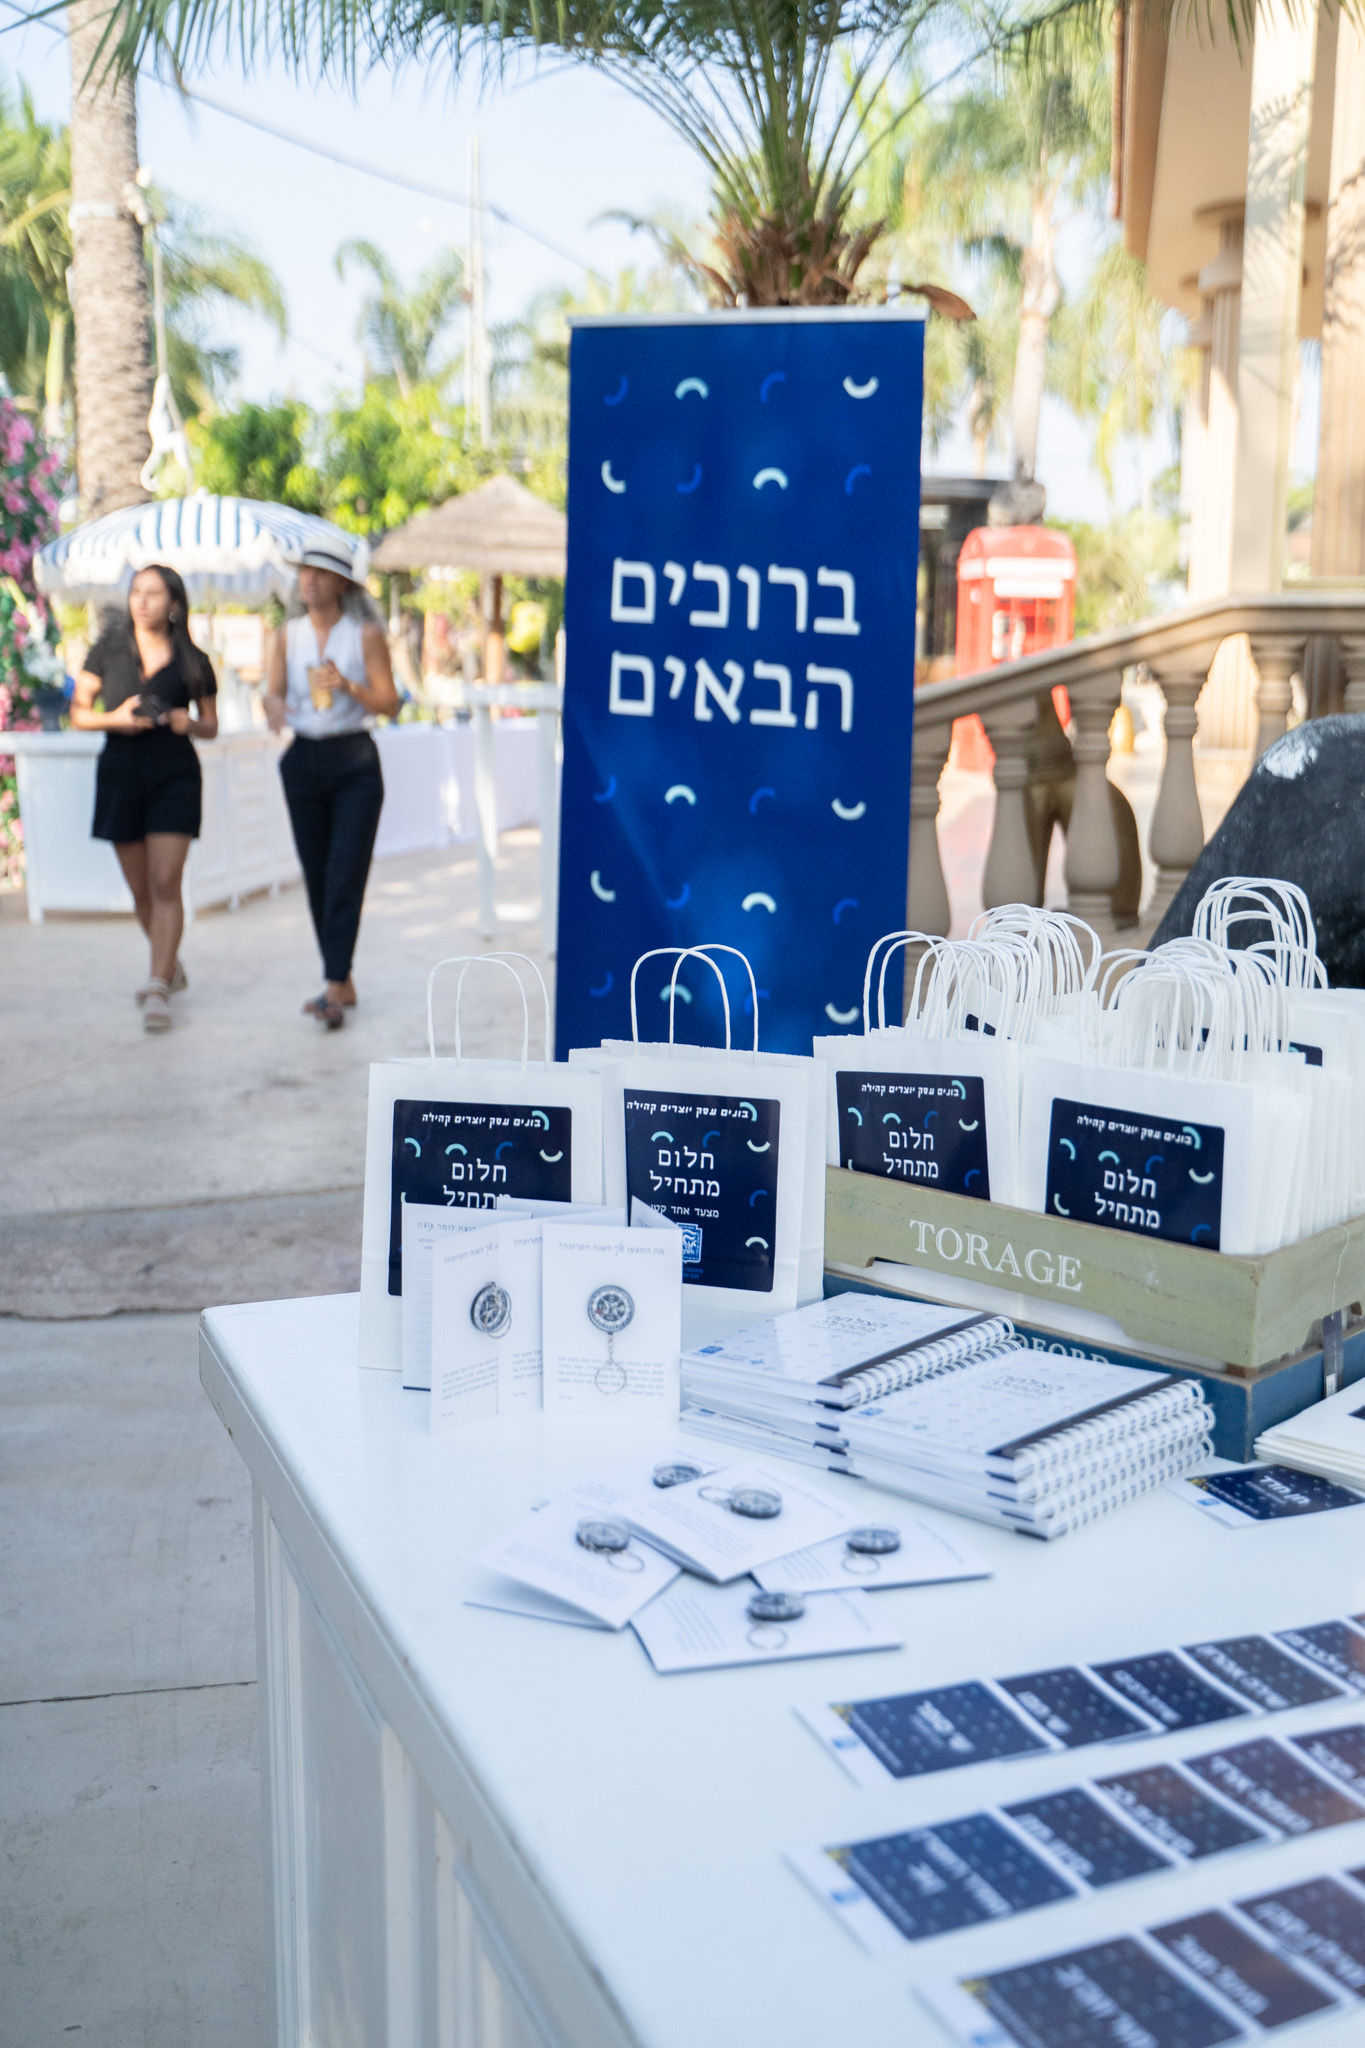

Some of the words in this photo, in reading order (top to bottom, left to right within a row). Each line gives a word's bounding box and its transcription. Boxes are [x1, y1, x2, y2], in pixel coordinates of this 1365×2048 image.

[611, 557, 861, 636] ברוכים
[609, 650, 854, 733] הבאים
[861, 1083, 886, 1097] קהילה
[888, 1085, 916, 1094] יוצרים
[918, 1086, 934, 1098] עסק
[937, 1087, 960, 1097] בונים
[626, 1100, 657, 1114] קהילה
[660, 1104, 692, 1114] יוצרים
[695, 1107, 717, 1118] עסק
[720, 1109, 749, 1119] בונים
[422, 1112, 452, 1127] קהילה
[454, 1115, 486, 1125] יוצרים
[489, 1116, 510, 1129] עסק
[513, 1118, 542, 1128] בונים
[1076, 1114, 1106, 1132] קהילה
[889, 1126, 934, 1150] חלום
[658, 1145, 715, 1170] חלום
[451, 1157, 507, 1183] חלום
[882, 1152, 939, 1179] מתחיל
[649, 1169, 721, 1197] מתחיל
[1103, 1168, 1157, 1199] חלום
[443, 1184, 512, 1210] תחיל
[670, 1205, 690, 1216] אחד
[694, 1207, 720, 1218] מצעד
[1094, 1191, 1161, 1229] מתחיל
[909, 1219, 1083, 1292] TORAGE
